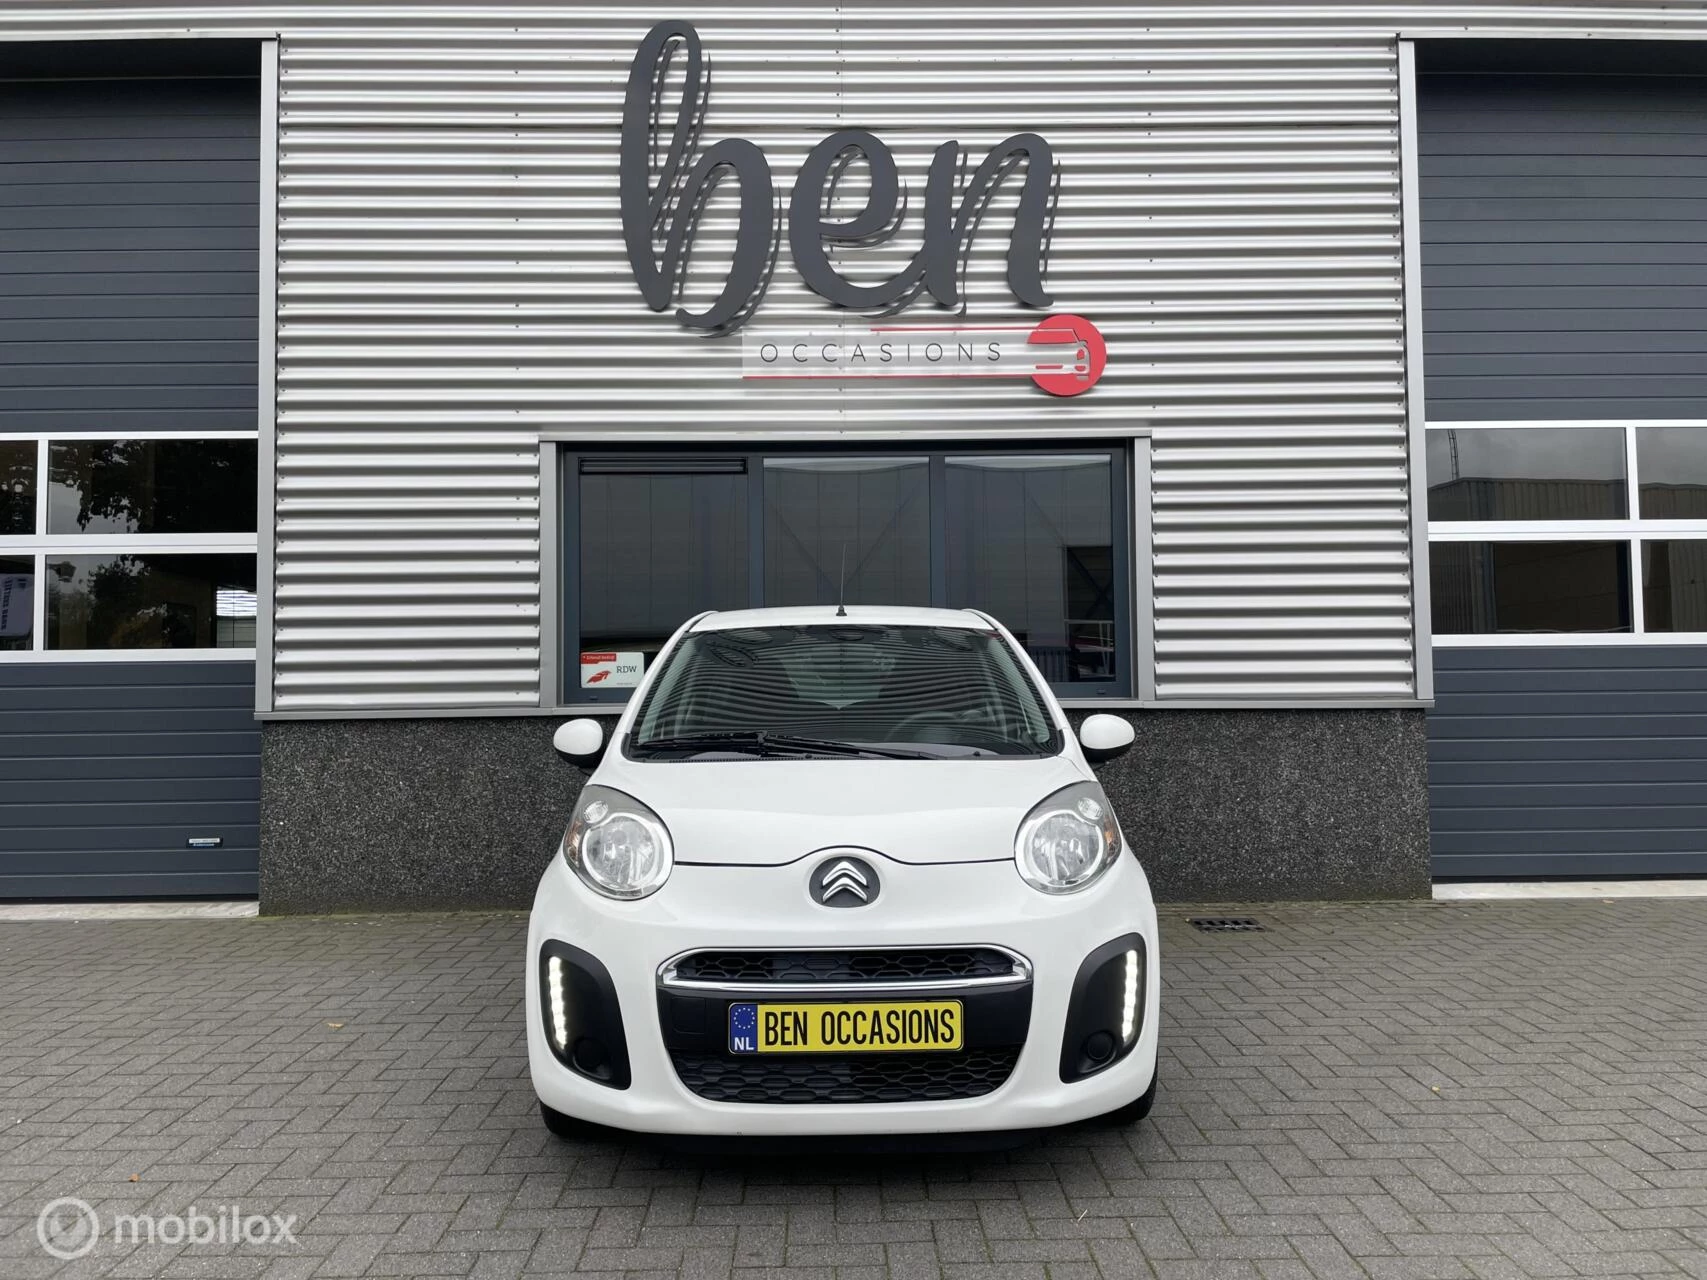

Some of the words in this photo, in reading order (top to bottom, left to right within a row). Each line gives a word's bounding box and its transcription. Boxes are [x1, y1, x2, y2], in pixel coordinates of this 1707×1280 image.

[620, 20, 1054, 328] ben
[760, 342, 1002, 363] OCCASIONS
[616, 665, 637, 674] RDW
[764, 1011, 808, 1046] BEN
[820, 1009, 955, 1045] OCCASIONS
[733, 1036, 754, 1051] NL
